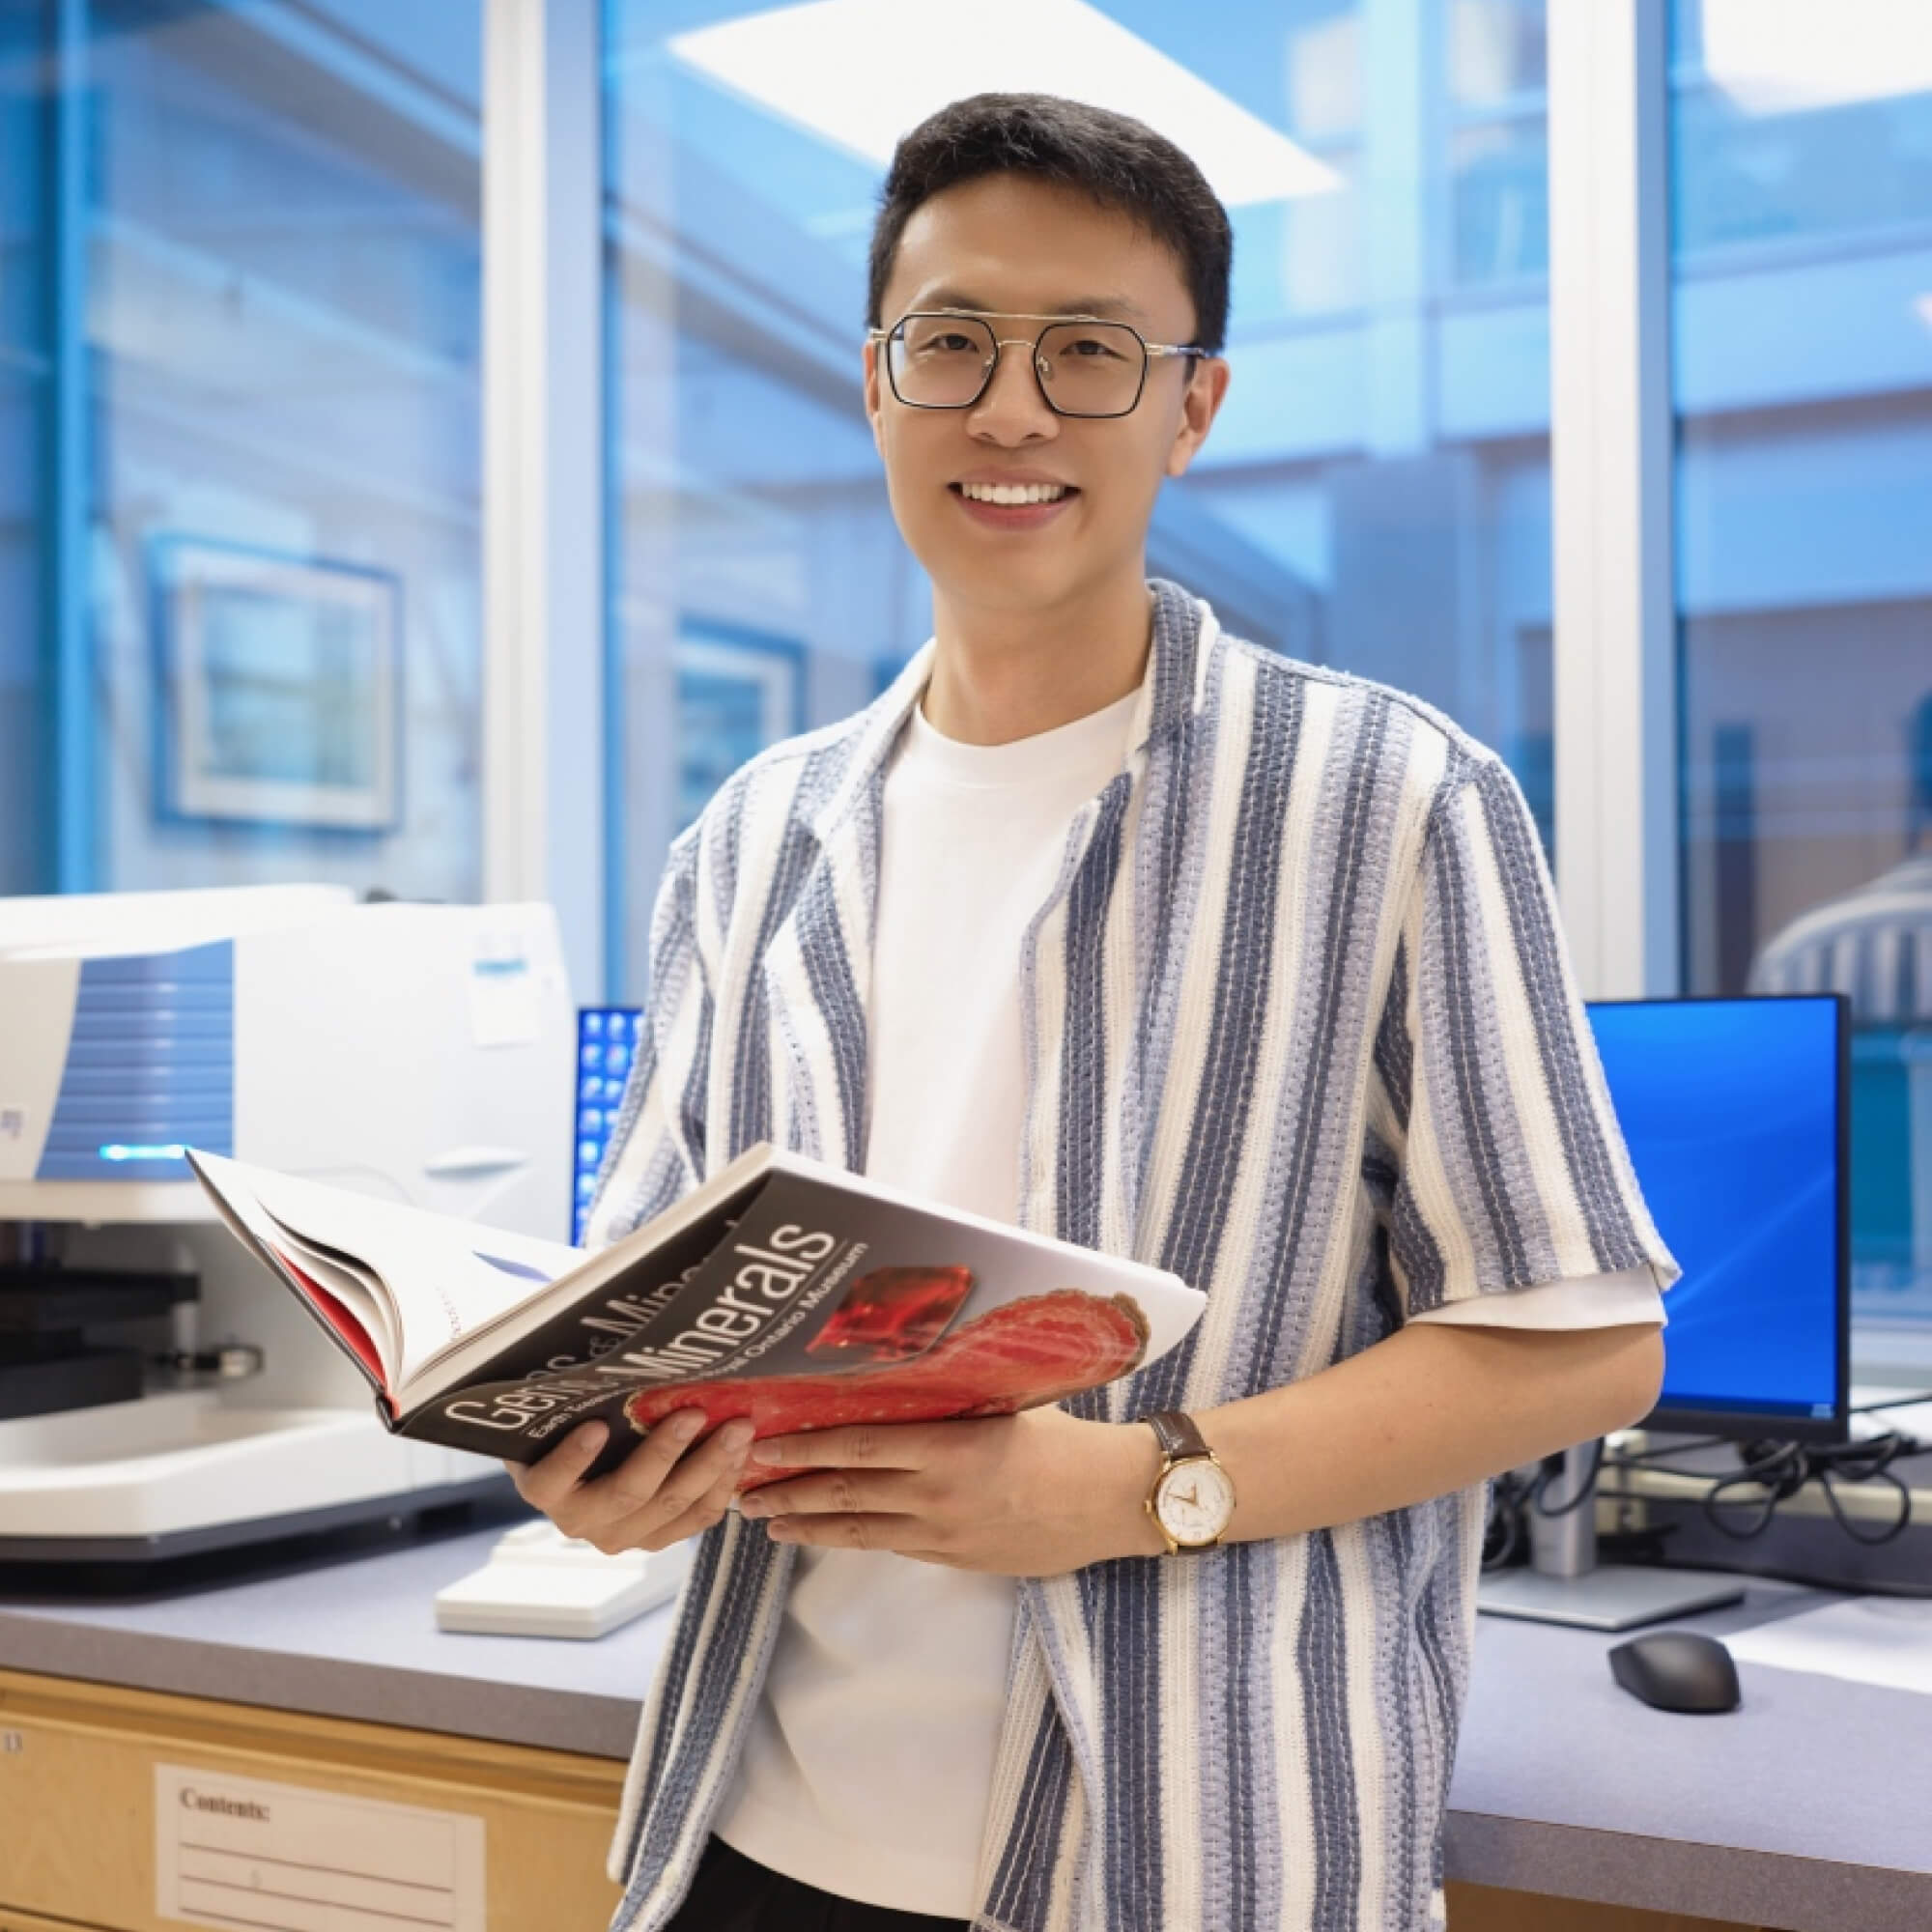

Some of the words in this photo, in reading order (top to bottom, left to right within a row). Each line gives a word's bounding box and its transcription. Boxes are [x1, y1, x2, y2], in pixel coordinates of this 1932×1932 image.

[594, 1224, 835, 1379] Minerals
[744, 1310, 807, 1358] Ontario
[798, 1241, 869, 1310] Museum
[179, 1786, 271, 1824] Contents:
